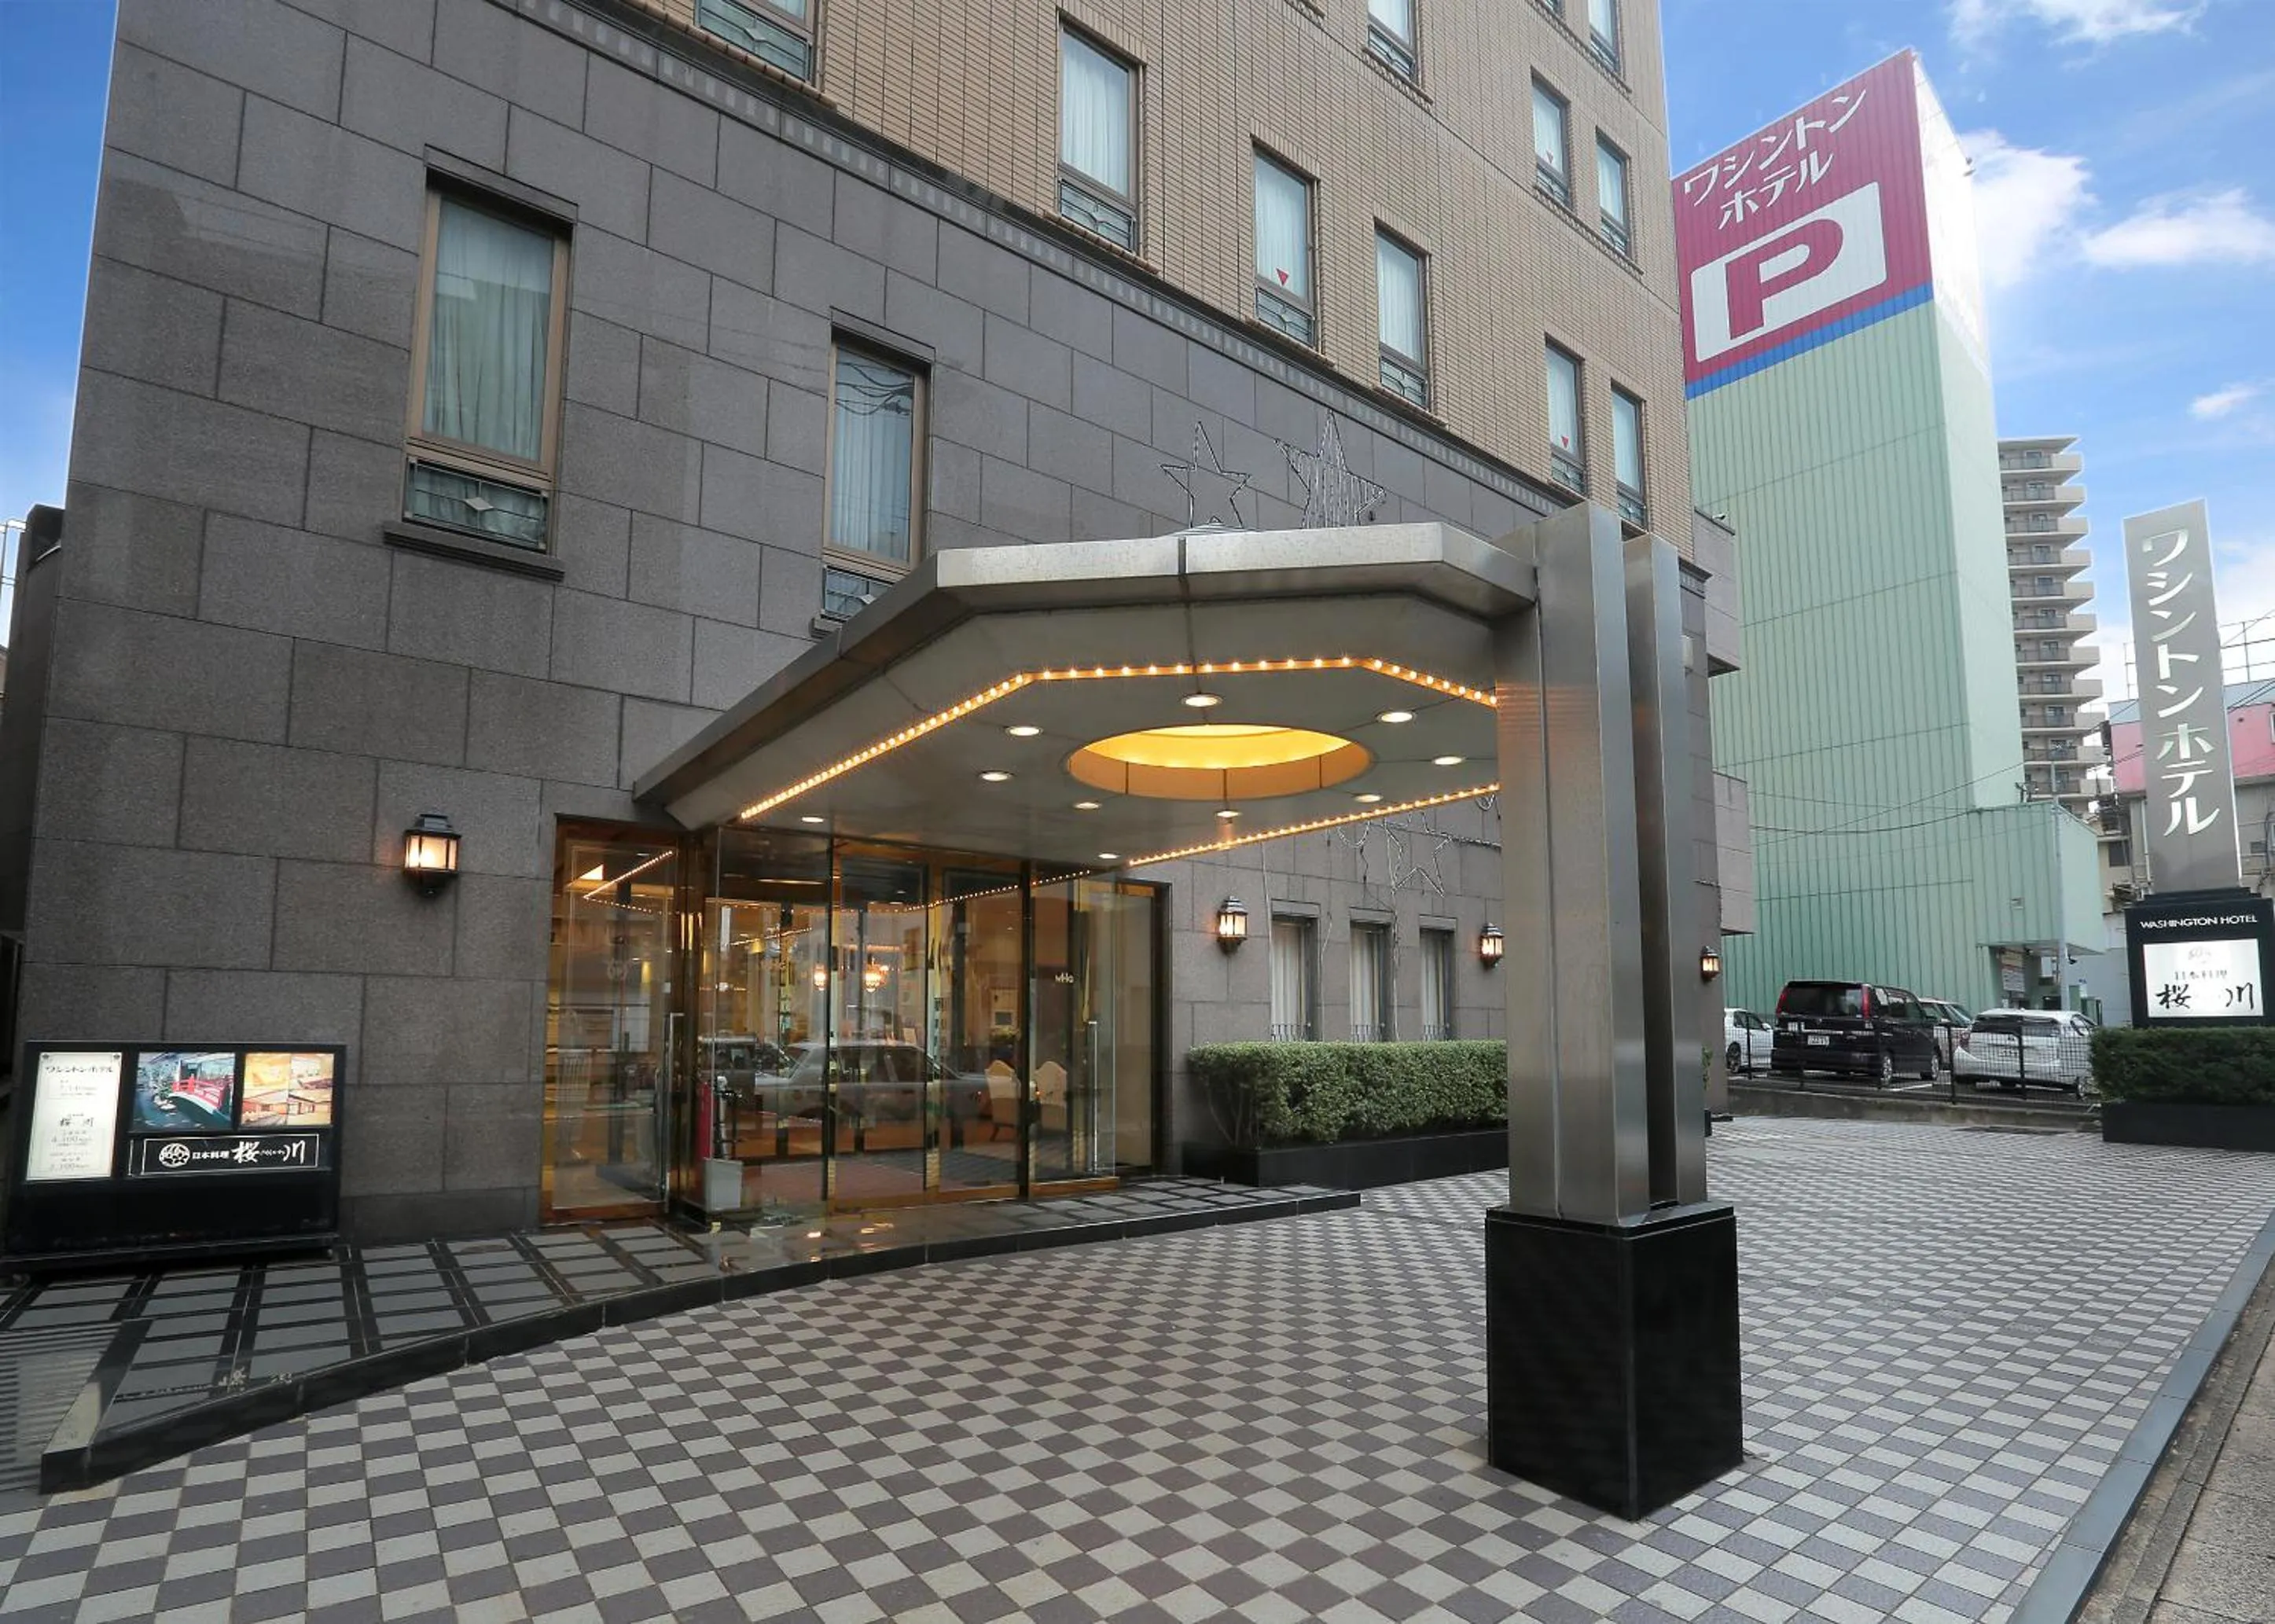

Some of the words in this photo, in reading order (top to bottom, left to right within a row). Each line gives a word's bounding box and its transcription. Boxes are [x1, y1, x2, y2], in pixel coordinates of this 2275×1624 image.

[1684, 89, 1867, 207] ワシントン
[1717, 153, 1834, 230] ホテル
[1725, 219, 1844, 341] P
[2142, 528, 2220, 837] ワシントンホテル
[2140, 917, 2218, 929] WASHINGTON
[2220, 914, 2258, 924] HOTEL
[192, 1150, 230, 1159] 日本料理
